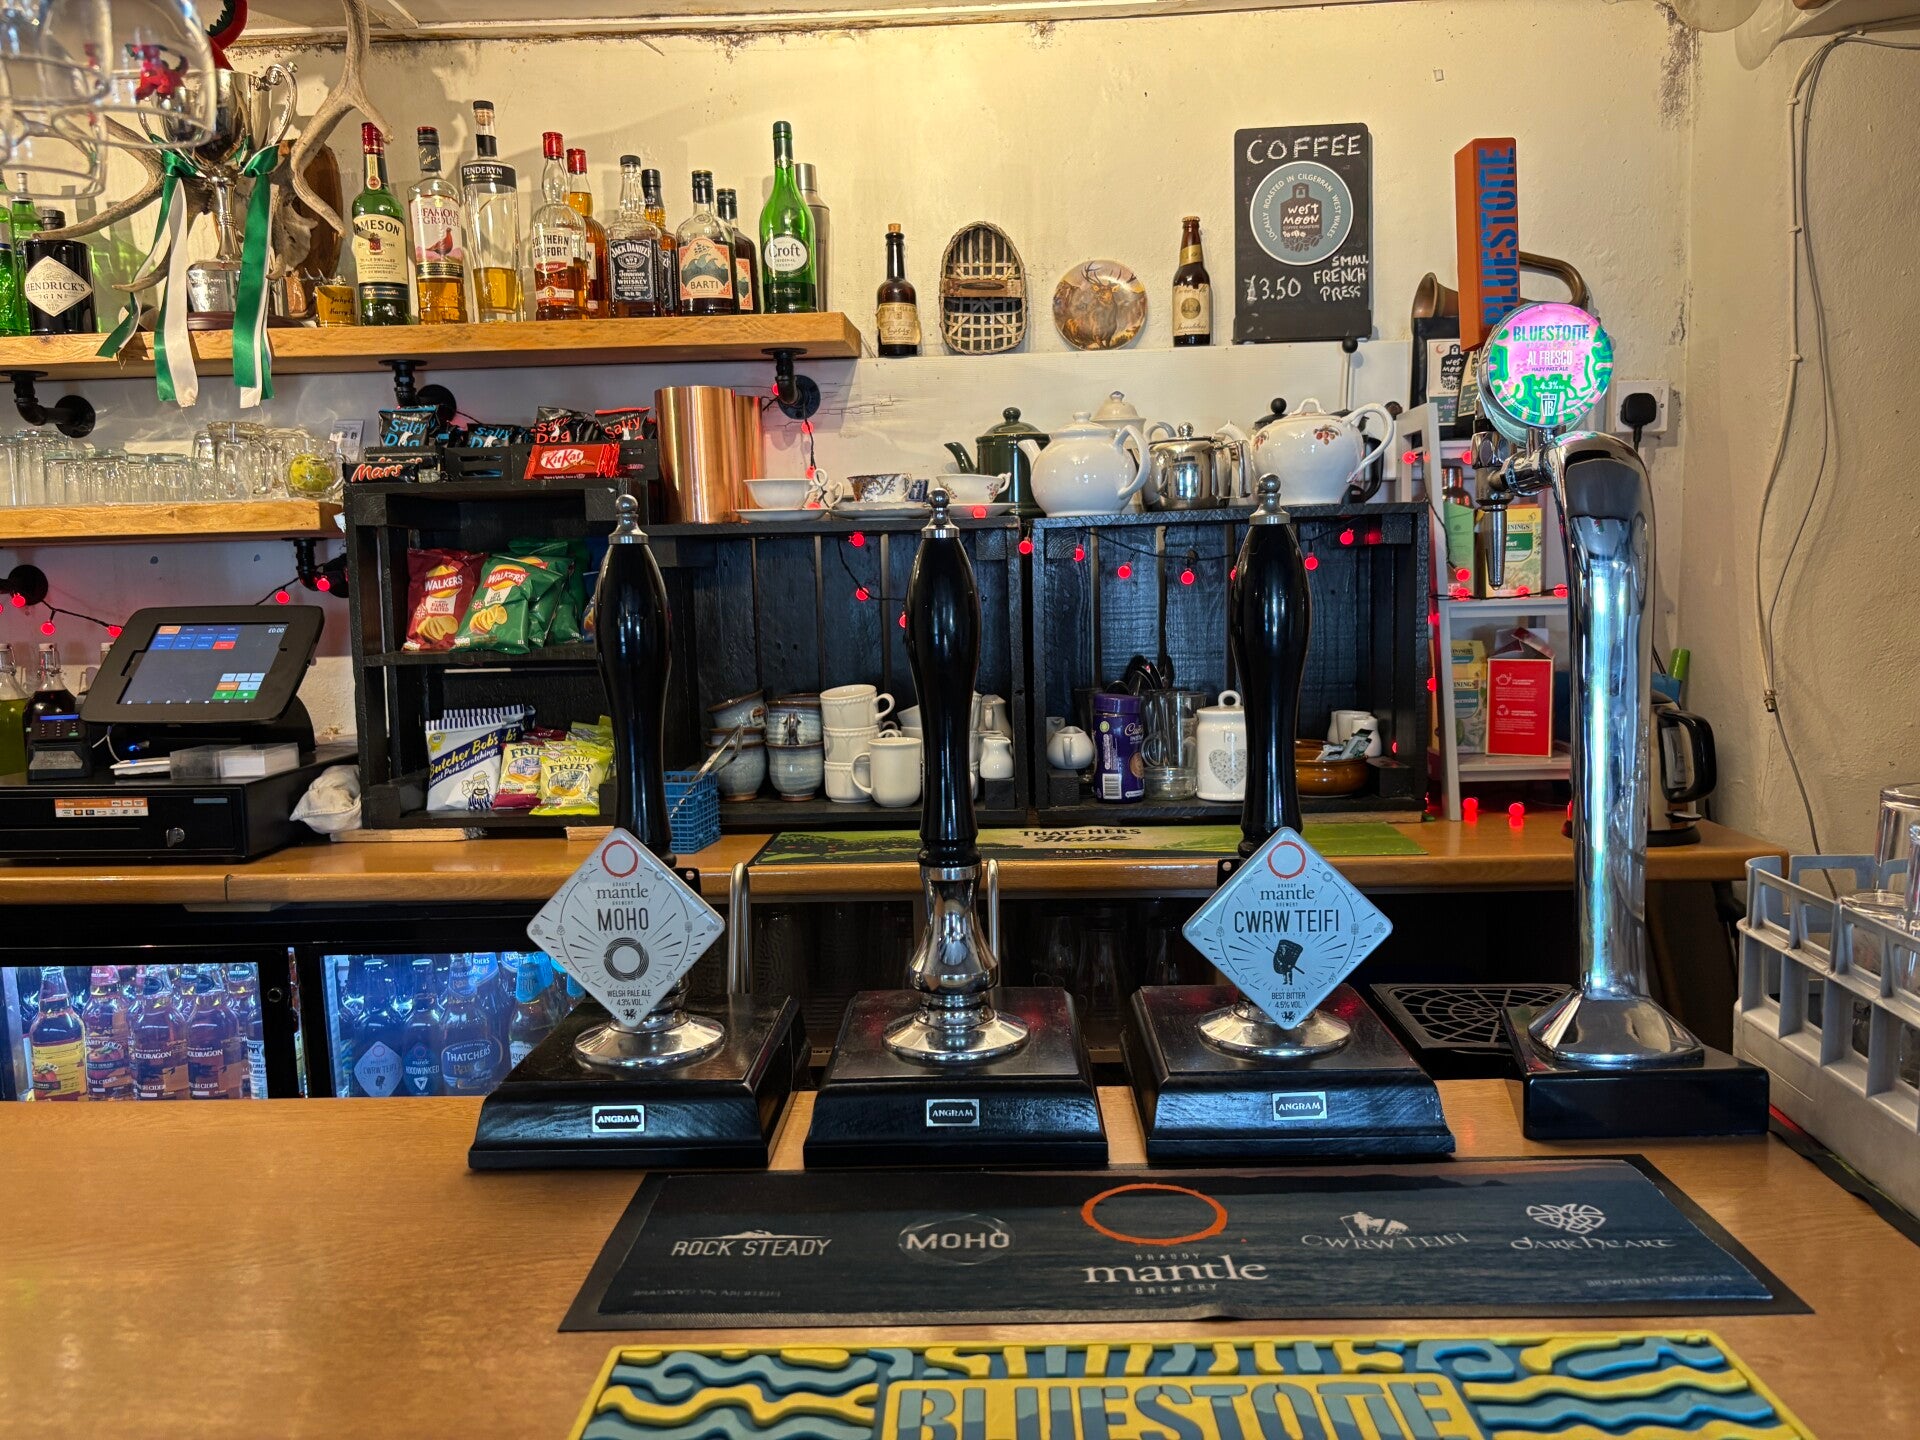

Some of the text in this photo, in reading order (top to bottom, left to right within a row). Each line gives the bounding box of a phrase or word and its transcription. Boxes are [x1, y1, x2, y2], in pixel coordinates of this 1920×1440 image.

[1246, 134, 1361, 164] COFFEE
[463, 166, 503, 175] PENDERYN
[1262, 173, 1342, 241] LOCALLY ROASTED IN CILGERRAN WEST WALES
[611, 244, 627, 258] JACK
[769, 243, 801, 258] Croft
[1332, 255, 1369, 267] SMALL
[1313, 268, 1367, 284] FRENCH
[26, 281, 86, 292] HENDRICK'S
[690, 280, 719, 289] BARTI
[1320, 285, 1361, 301] PRESS
[1513, 324, 1590, 342] BLUESTONE
[1527, 349, 1573, 365] AL FRESCO
[1540, 381, 1559, 390] 4.3%
[390, 418, 427, 435] Salty
[474, 426, 513, 441] Salty
[604, 416, 640, 439] Salty
[545, 449, 581, 468] KitKat
[351, 463, 403, 482] Mars
[425, 576, 463, 591] WALKERS
[488, 571, 526, 584] WALKERS
[430, 732, 498, 780] Butcher Bob's
[549, 763, 595, 773] FRIES
[596, 883, 649, 899] mantle
[1260, 884, 1315, 900] mantle
[597, 907, 649, 931] MOHO
[1234, 909, 1340, 933] CWRW TEIFI
[616, 998, 631, 1006] 4.3%
[1271, 992, 1306, 1000] BEST BITTER
[1275, 1001, 1290, 1009] 4.5%
[446, 1045, 492, 1062] THATCHERS
[405, 1065, 440, 1076] HOODWINKED
[932, 1108, 974, 1118] ANGRAM
[1279, 1102, 1321, 1110] ANGRAM
[597, 1114, 640, 1124] ANGRAM
[671, 1239, 832, 1256] ROCK STEADY
[906, 1231, 1010, 1250] MOHO
[1301, 1232, 1470, 1249] CWRW TEIFI
[1082, 1254, 1270, 1283] mantle
[1135, 1283, 1218, 1295] BREWERY
